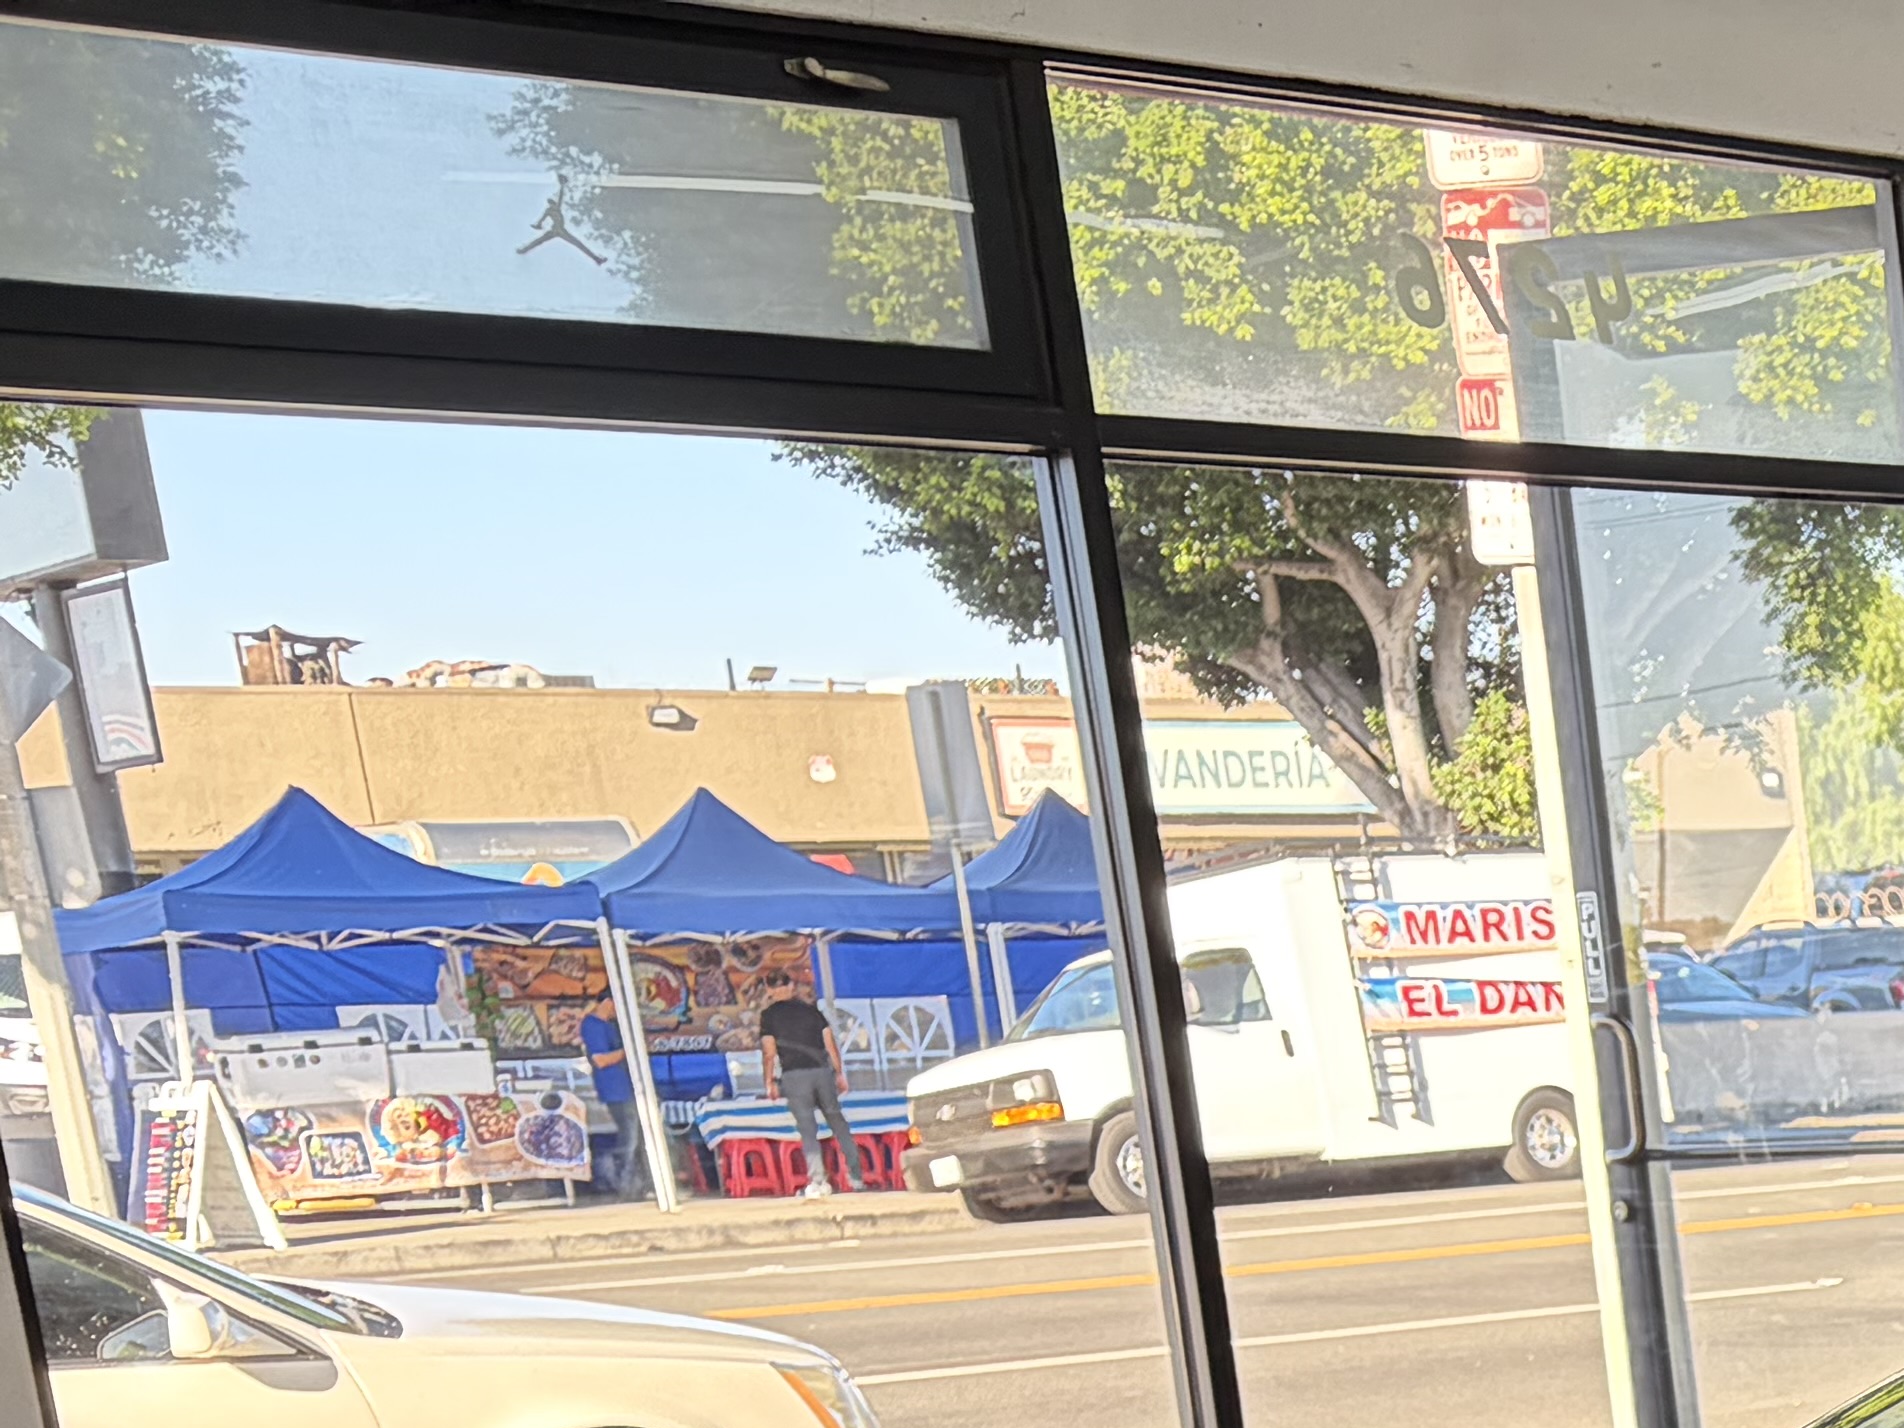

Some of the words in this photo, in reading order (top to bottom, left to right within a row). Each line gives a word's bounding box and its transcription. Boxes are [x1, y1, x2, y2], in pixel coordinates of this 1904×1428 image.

[1478, 144, 1490, 162] 5
[1463, 387, 1497, 427] NO
[1580, 901, 1602, 977] PULL
[1401, 983, 1460, 1018] EL
